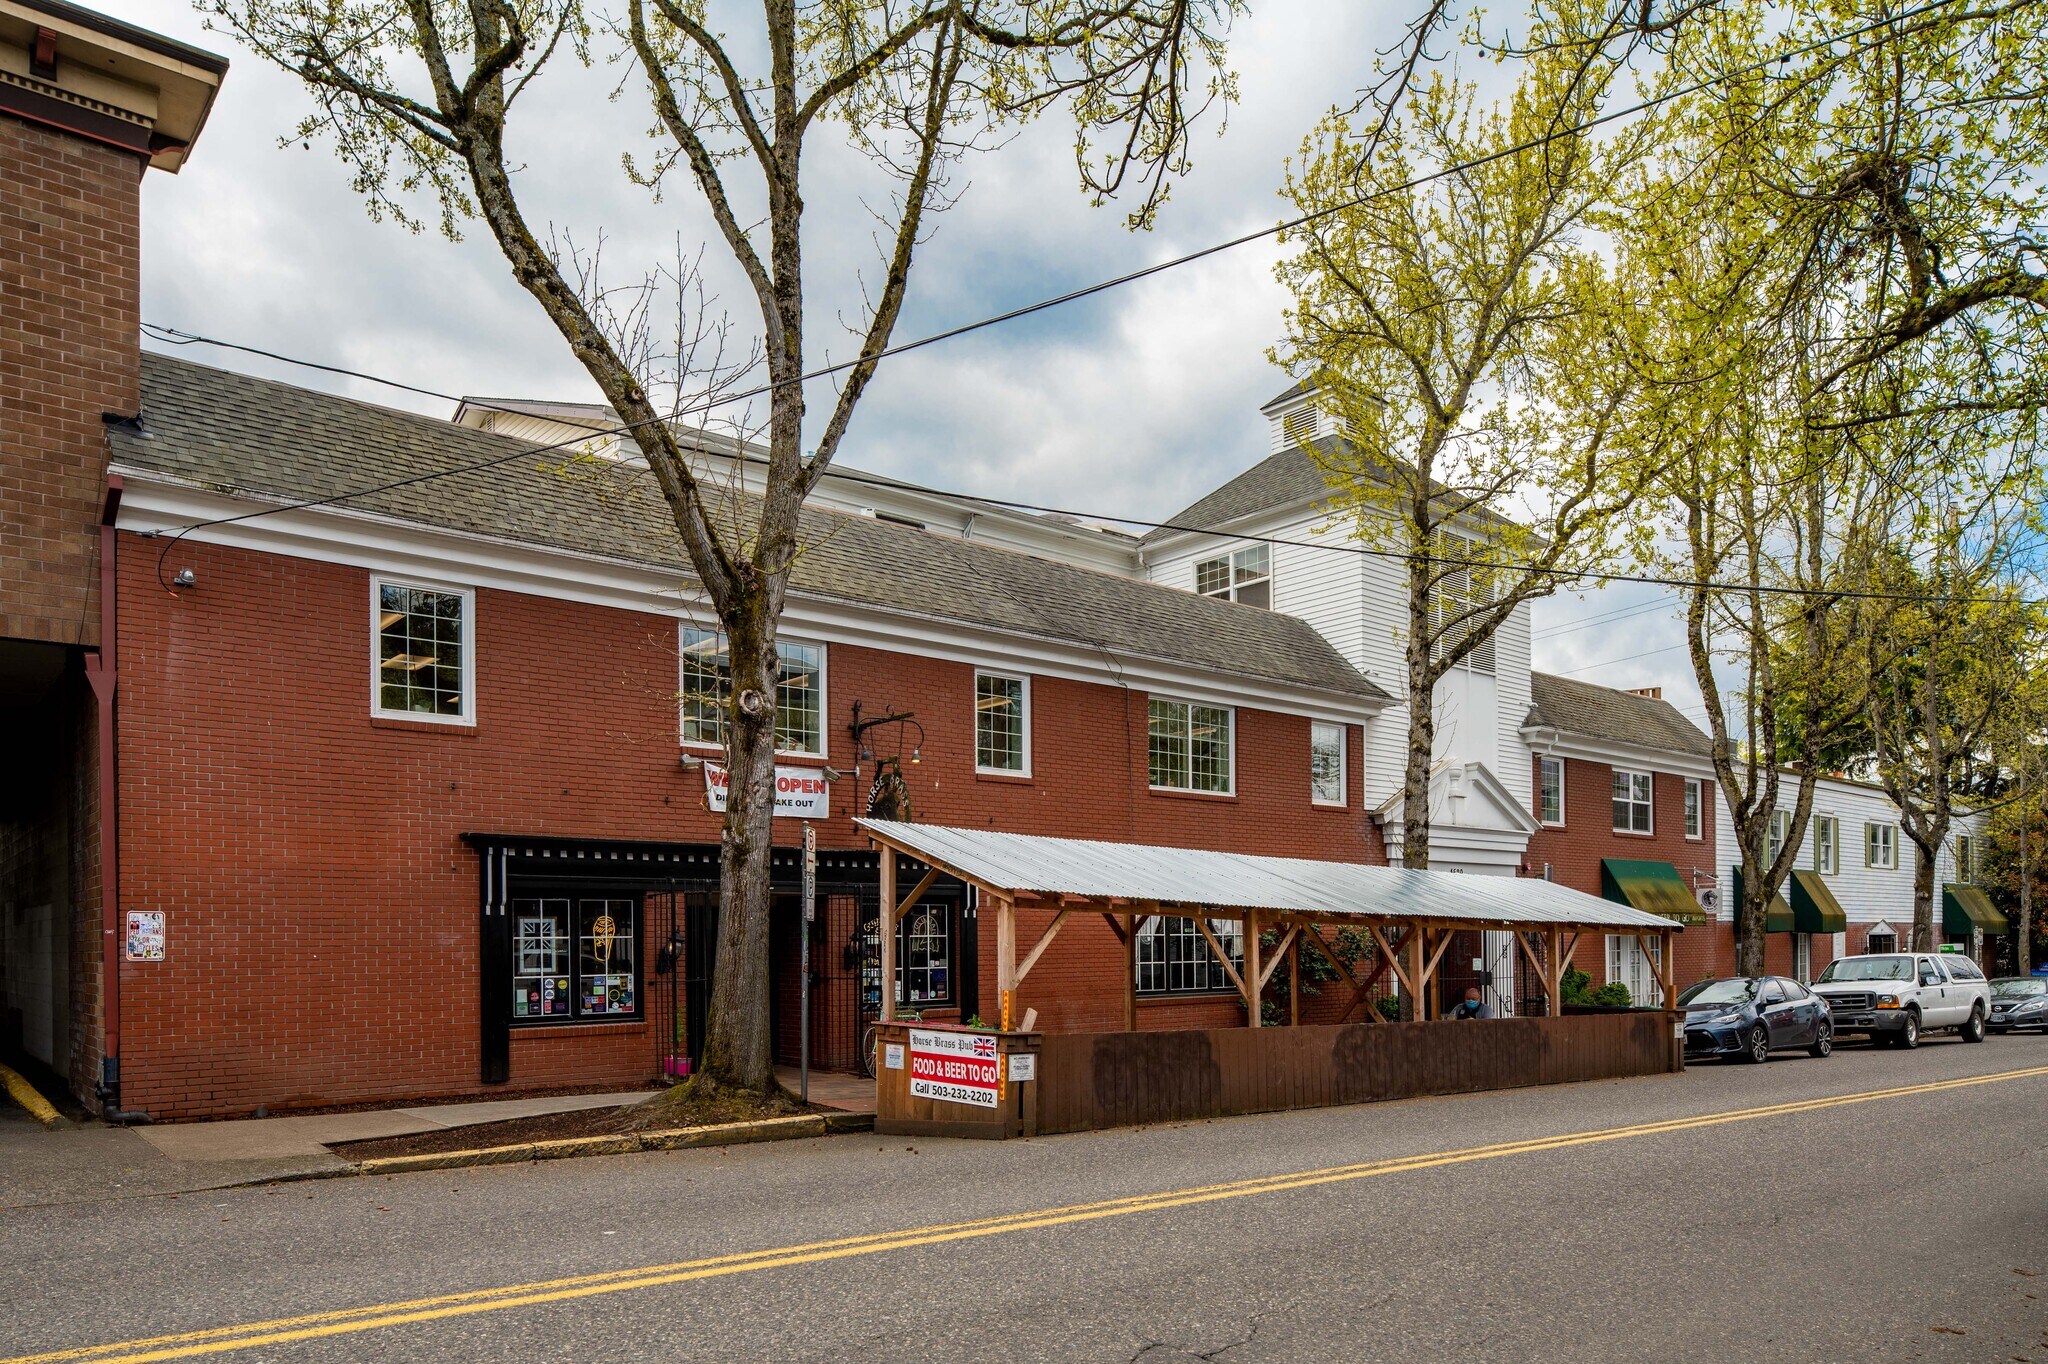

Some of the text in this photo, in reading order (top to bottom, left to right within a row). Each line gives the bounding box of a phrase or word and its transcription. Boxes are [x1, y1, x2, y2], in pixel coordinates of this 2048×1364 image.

[776, 777, 826, 795] OPEN
[866, 775, 885, 812] HORSE
[775, 799, 793, 807] AKE
[795, 800, 814, 808] OUT
[912, 1034, 974, 1052] Horse Brass Pub
[913, 1057, 936, 1076] FOOD
[936, 1060, 944, 1077] &
[944, 1061, 967, 1080] BEER
[967, 1063, 980, 1082] TO
[981, 1065, 997, 1084] GO
[915, 1082, 993, 1104] Call 503-232-2202
